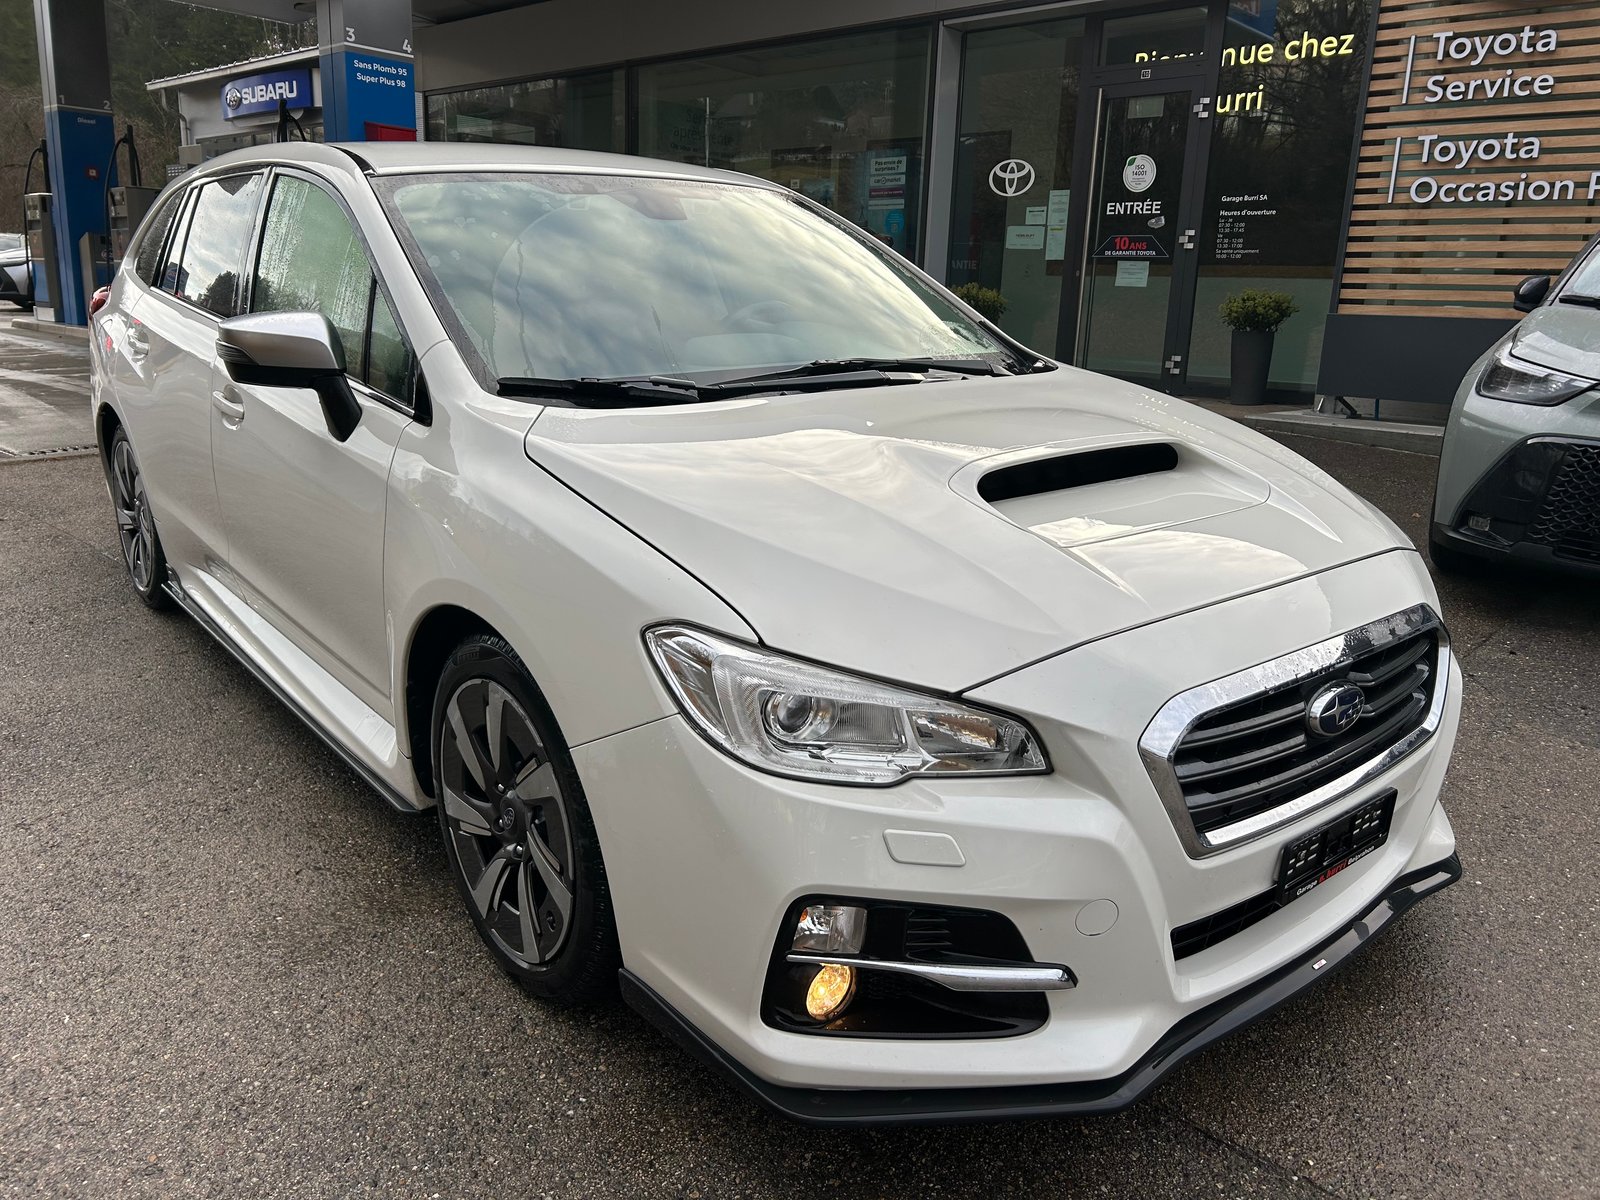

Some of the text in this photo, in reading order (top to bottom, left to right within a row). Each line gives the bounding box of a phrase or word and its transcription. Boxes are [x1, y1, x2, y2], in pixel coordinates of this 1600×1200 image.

[345, 27, 356, 42] 3
[402, 38, 412, 53] 4
[1284, 30, 1355, 60] chez
[1433, 25, 1558, 66] Toyota
[353, 60, 408, 76] Sans Plomb 95
[356, 72, 406, 88] Super Plus 98
[1424, 68, 1555, 103] Service
[241, 80, 297, 105] SUBARU
[103, 100, 111, 110] 2
[1417, 132, 1541, 169] Toyota
[1409, 172, 1575, 204] Occasion
[1106, 198, 1162, 215] ENTRÉE
[1113, 236, 1148, 250] 10 ANS
[1297, 880, 1318, 895] Garage
